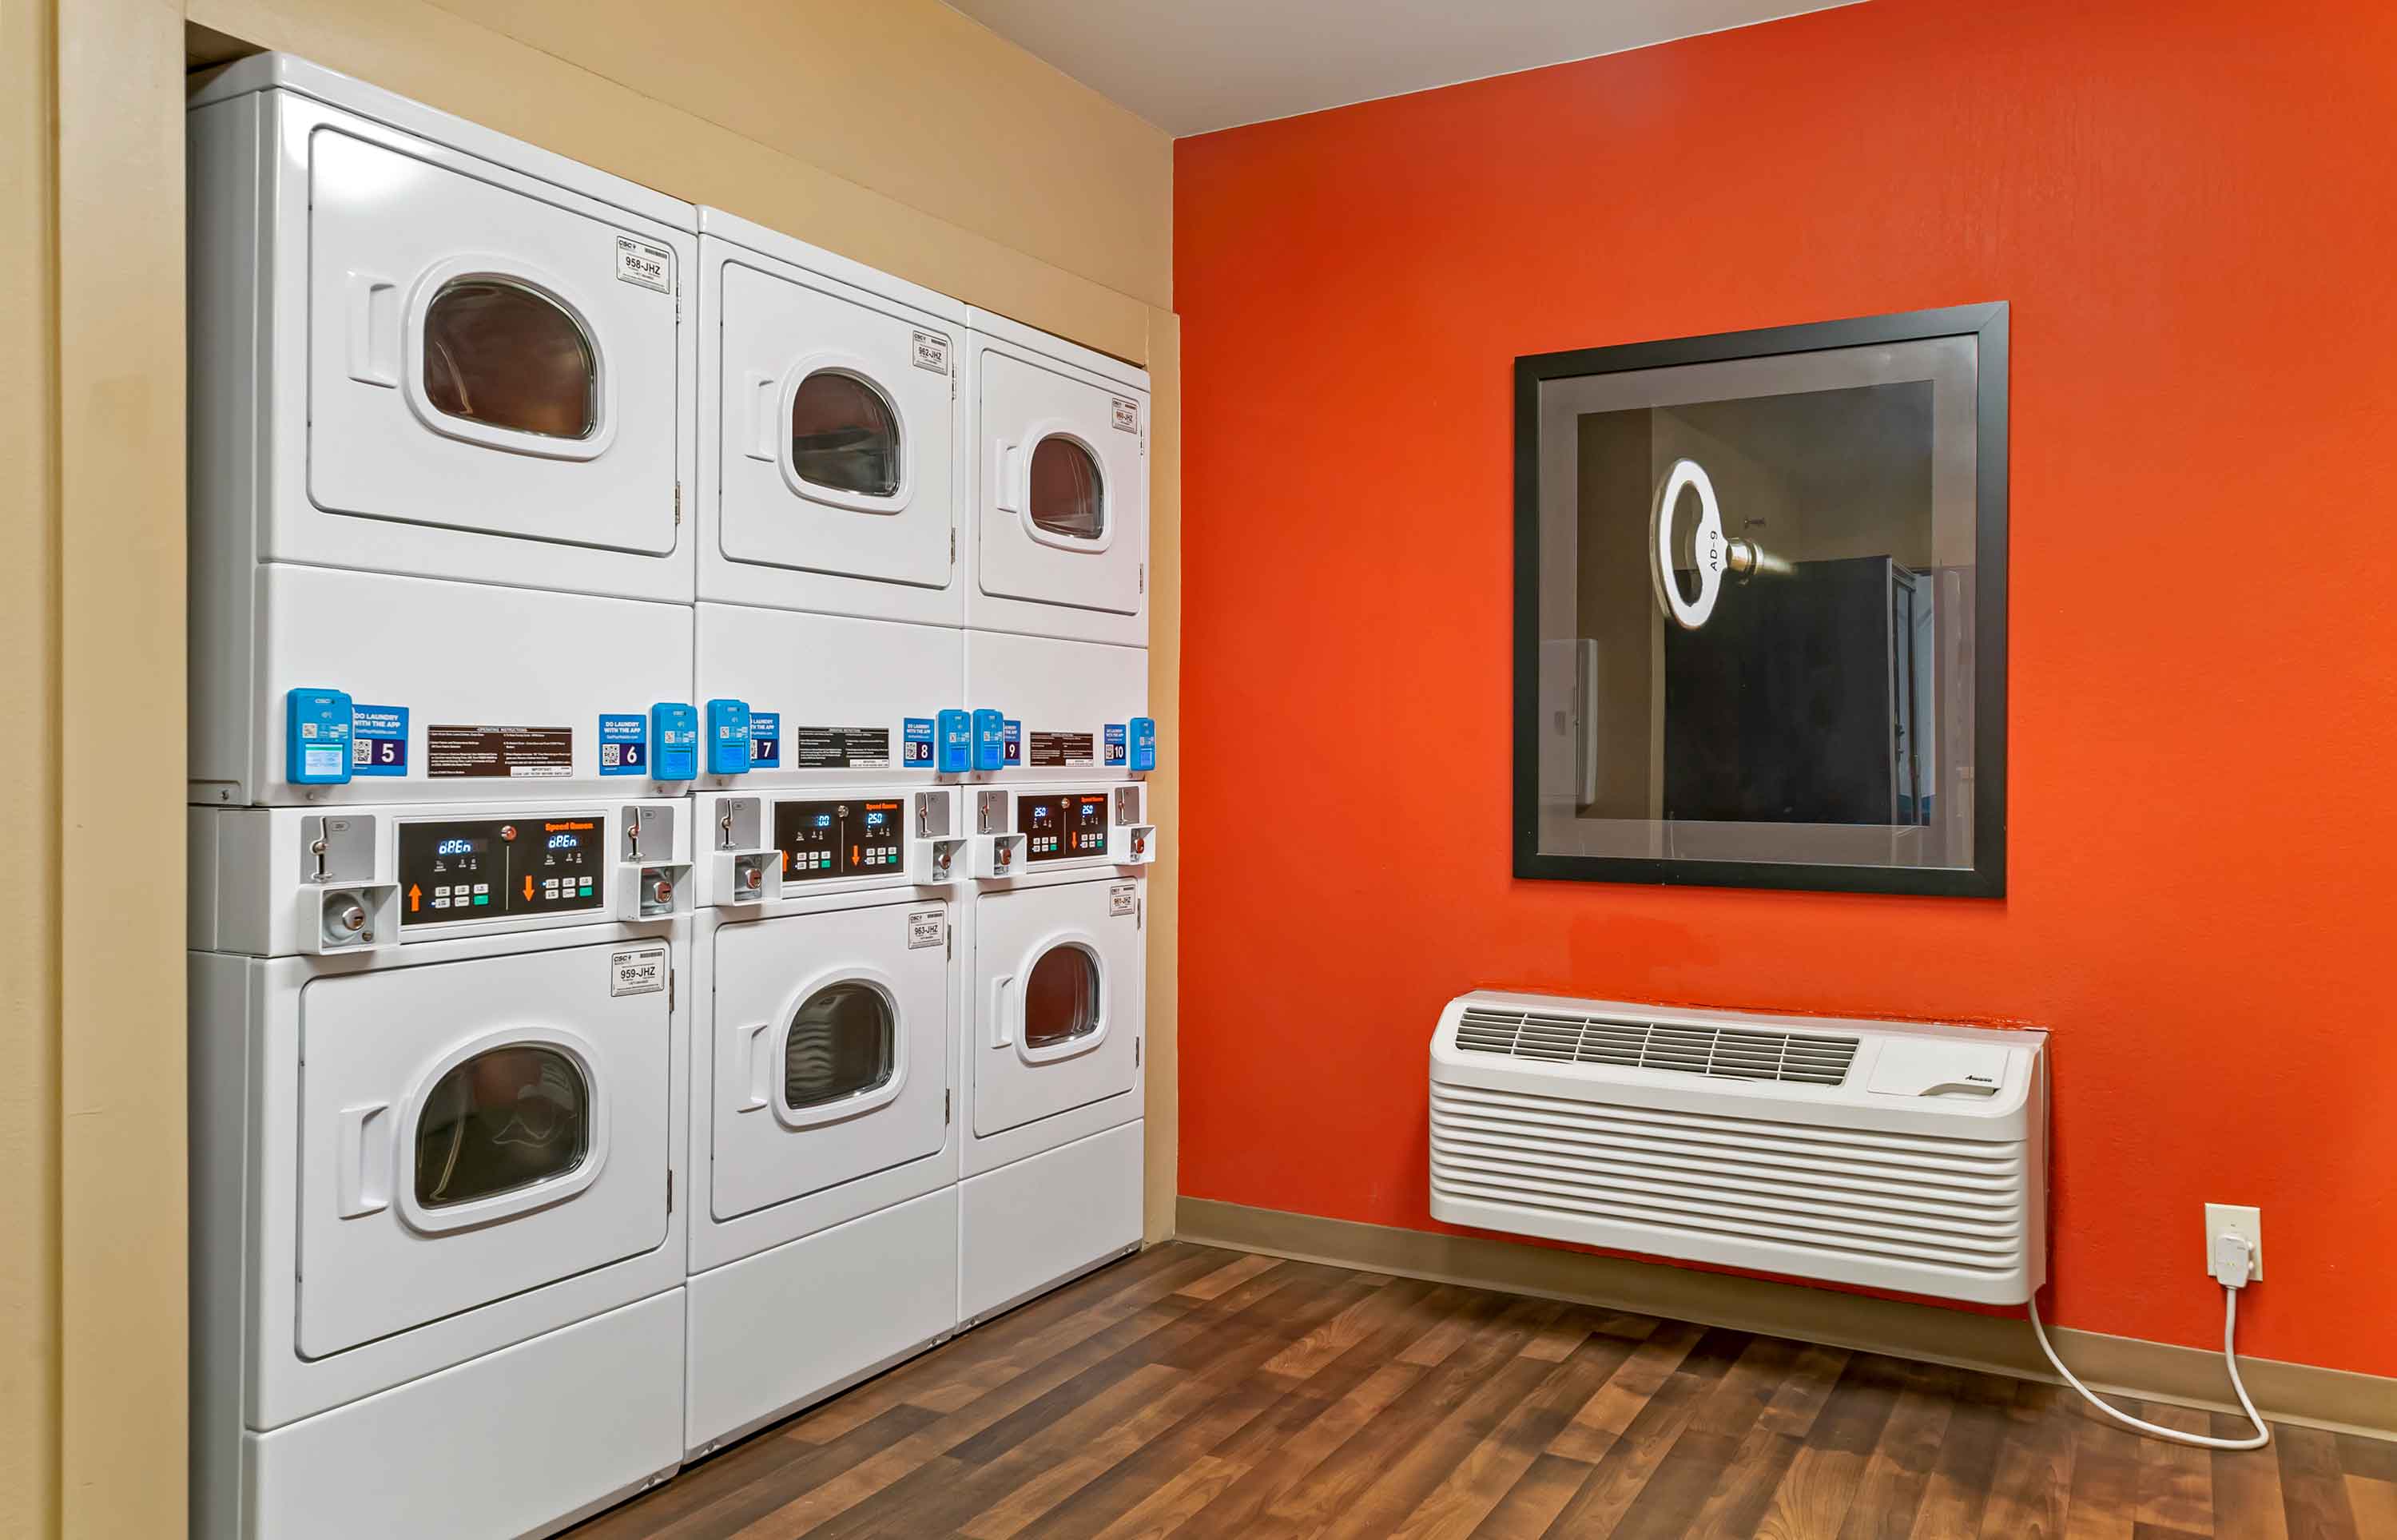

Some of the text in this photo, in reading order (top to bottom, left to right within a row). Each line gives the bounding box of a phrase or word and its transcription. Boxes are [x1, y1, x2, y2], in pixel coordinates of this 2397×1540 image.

[618, 240, 633, 248] CSC
[626, 256, 661, 276] 958-JHZ
[381, 743, 395, 763] 5
[626, 745, 638, 764] 6
[763, 741, 772, 758] 7
[920, 744, 928, 759] 8
[1009, 744, 1016, 757] 9
[1115, 745, 1123, 758] 10
[545, 822, 569, 832] Speed
[620, 966, 656, 979] 959-JHZ
